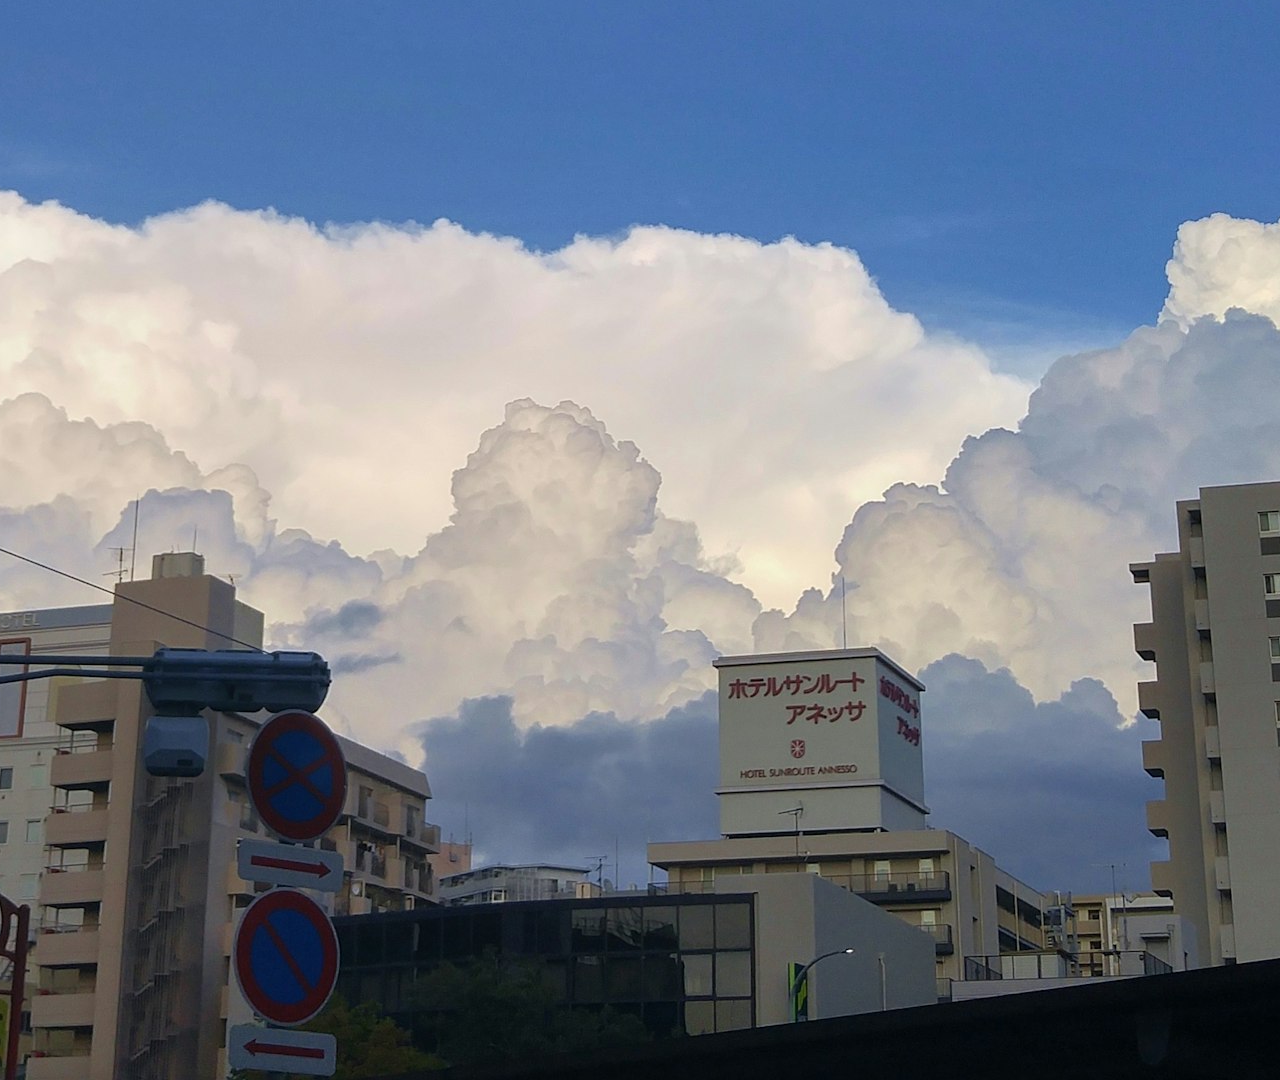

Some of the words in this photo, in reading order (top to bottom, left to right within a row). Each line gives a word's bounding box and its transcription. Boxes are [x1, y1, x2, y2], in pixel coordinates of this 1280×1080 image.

[728, 672, 865, 699] ホテルサンルート
[785, 701, 867, 725] アネッサ
[740, 769, 767, 779] HOTEL
[769, 767, 815, 777] SUNROUTE
[817, 764, 858, 774] ANNESSO
